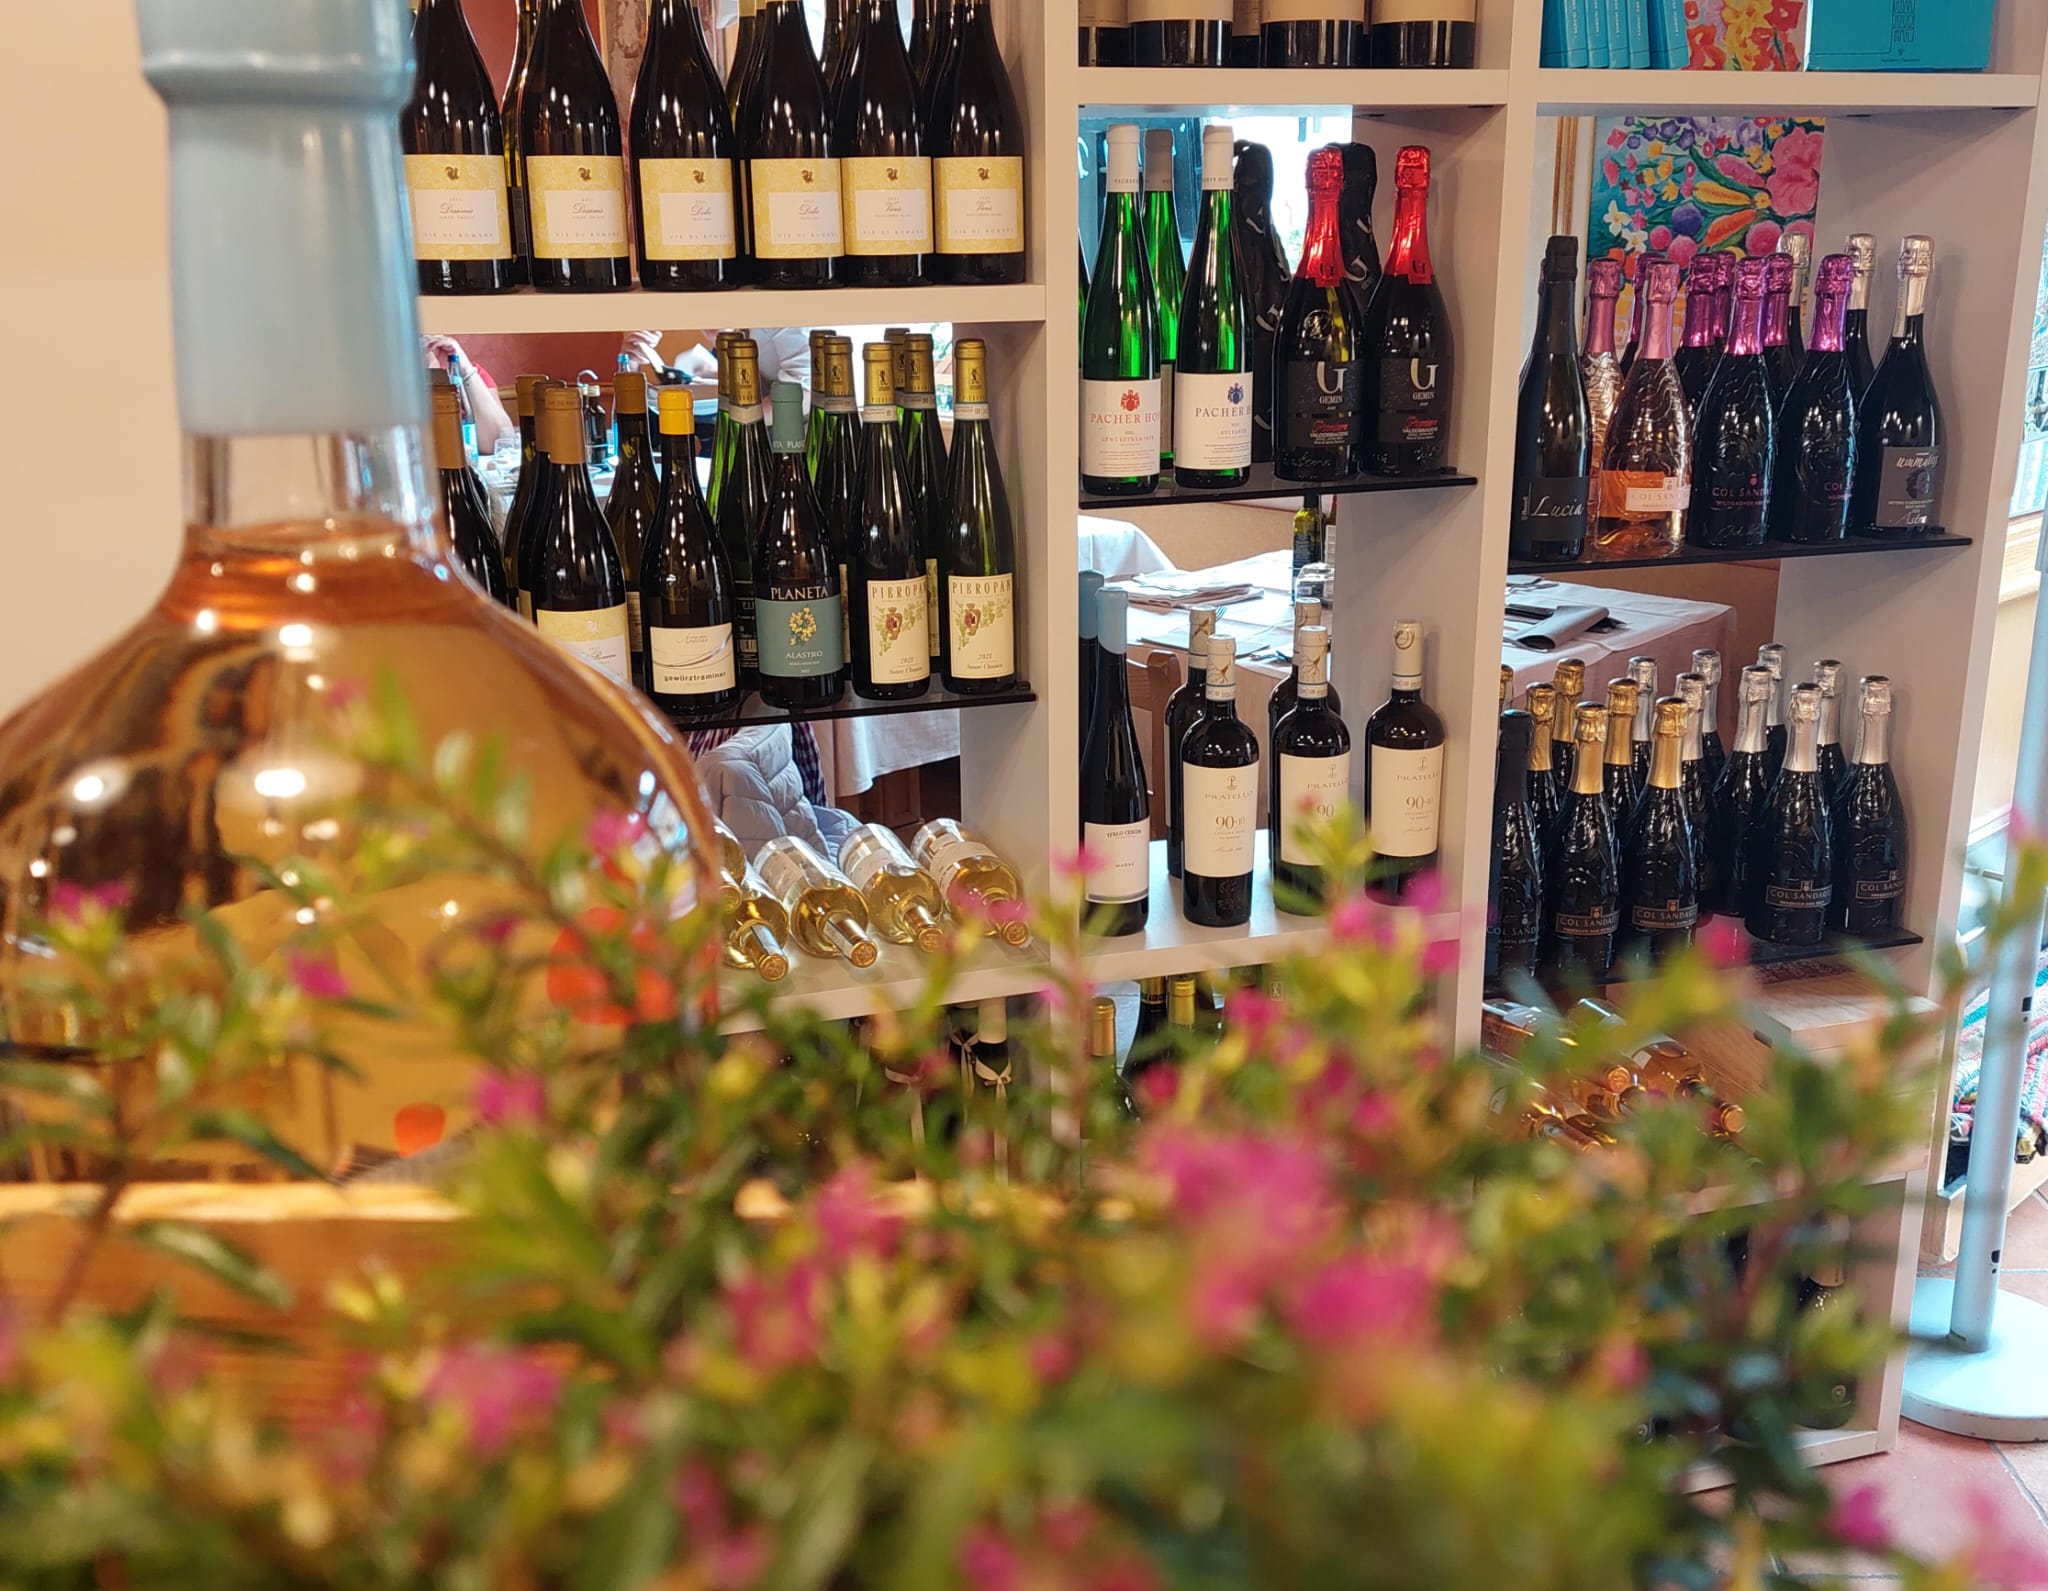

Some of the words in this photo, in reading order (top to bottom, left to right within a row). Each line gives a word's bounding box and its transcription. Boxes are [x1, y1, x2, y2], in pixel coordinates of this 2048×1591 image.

[1196, 406, 1244, 417] PACHER
[1090, 412, 1141, 424] PACHER
[1145, 410, 1160, 422] HO
[1712, 487, 1734, 497] COL
[1530, 496, 1584, 517] Lucia
[952, 579, 1011, 594] PIEROPAN
[770, 586, 829, 600] PLANETA
[786, 650, 824, 659] ALASTRO
[664, 672, 726, 682] gewürztraminer
[1860, 883, 1880, 892] COL
[1770, 889, 1790, 898] COL
[1636, 909, 1656, 918] COL
[1560, 916, 1580, 926] COL
[1486, 926, 1507, 936] COL
